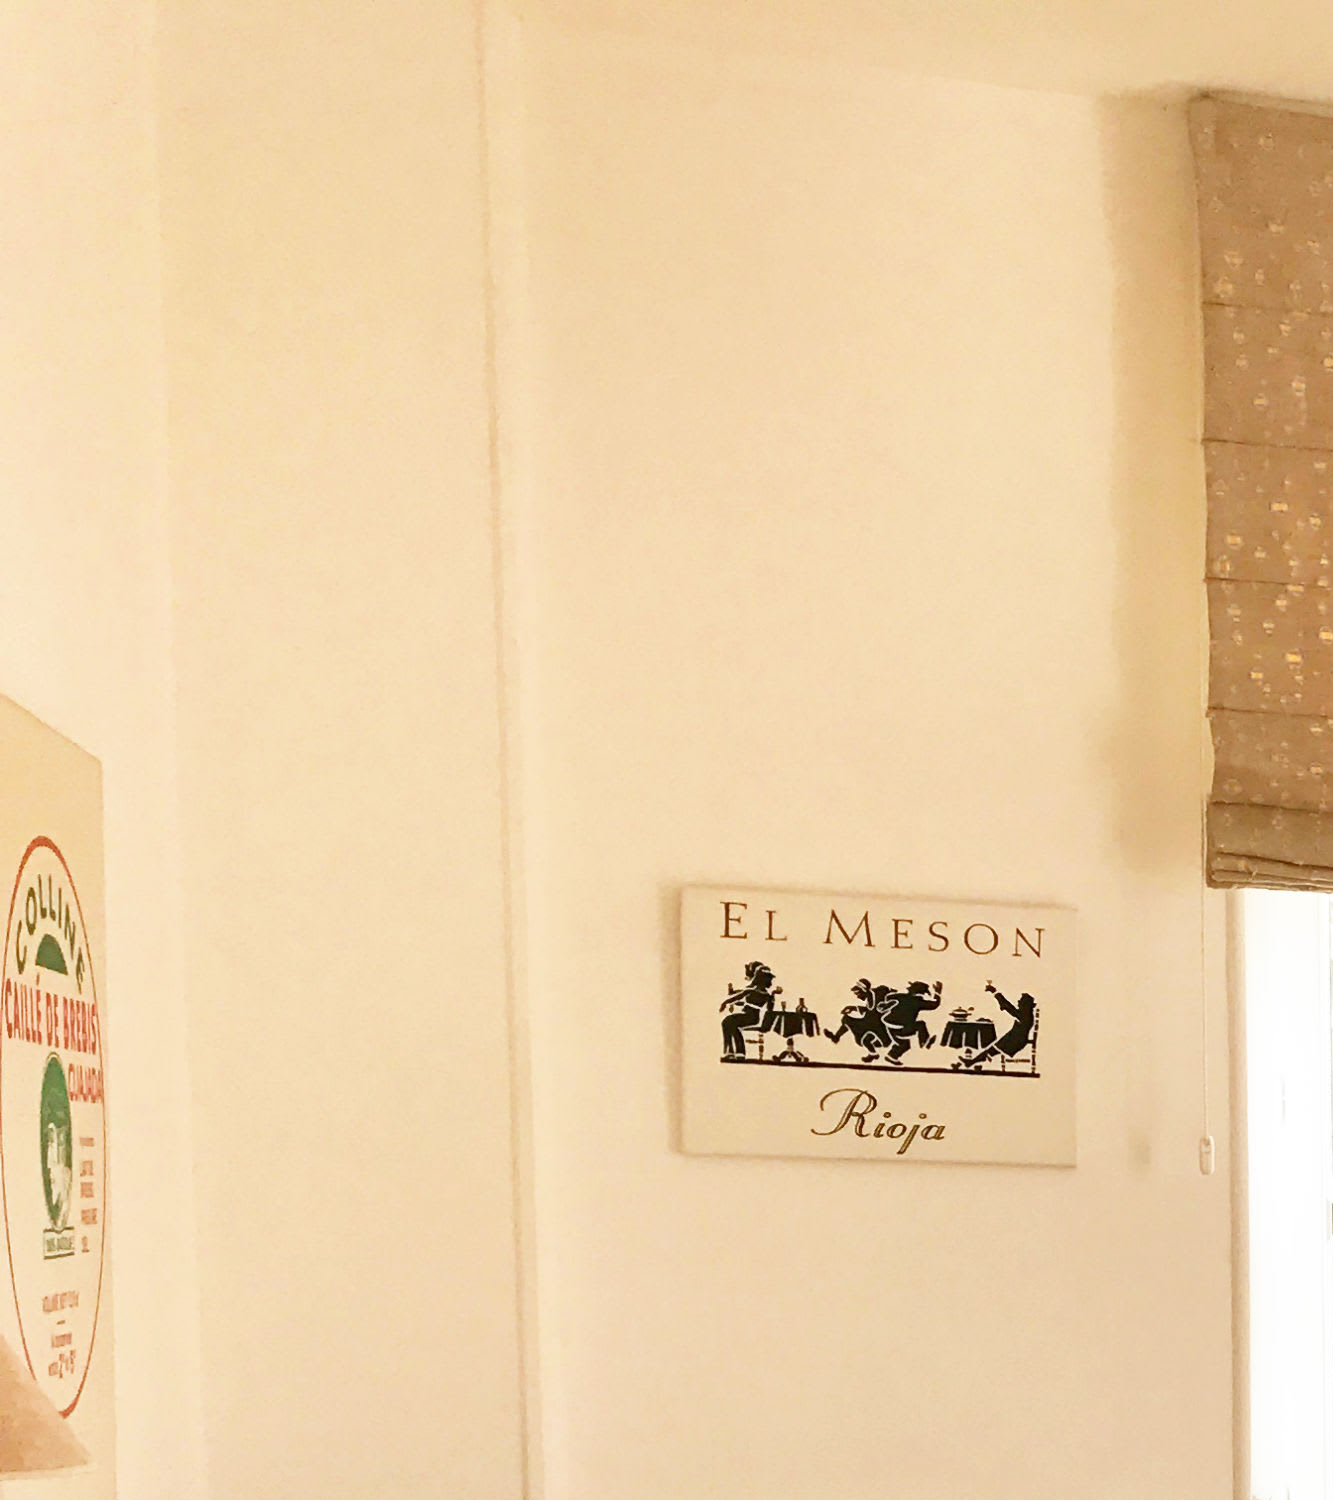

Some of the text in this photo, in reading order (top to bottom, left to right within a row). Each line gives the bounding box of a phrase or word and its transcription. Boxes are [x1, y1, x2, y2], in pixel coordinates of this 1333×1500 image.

[15, 873, 86, 995] COLLINE
[719, 900, 1046, 959] EL MESON
[4, 972, 97, 1055] CAILLÉ DE BREBIS
[810, 1087, 947, 1156] Rioja
